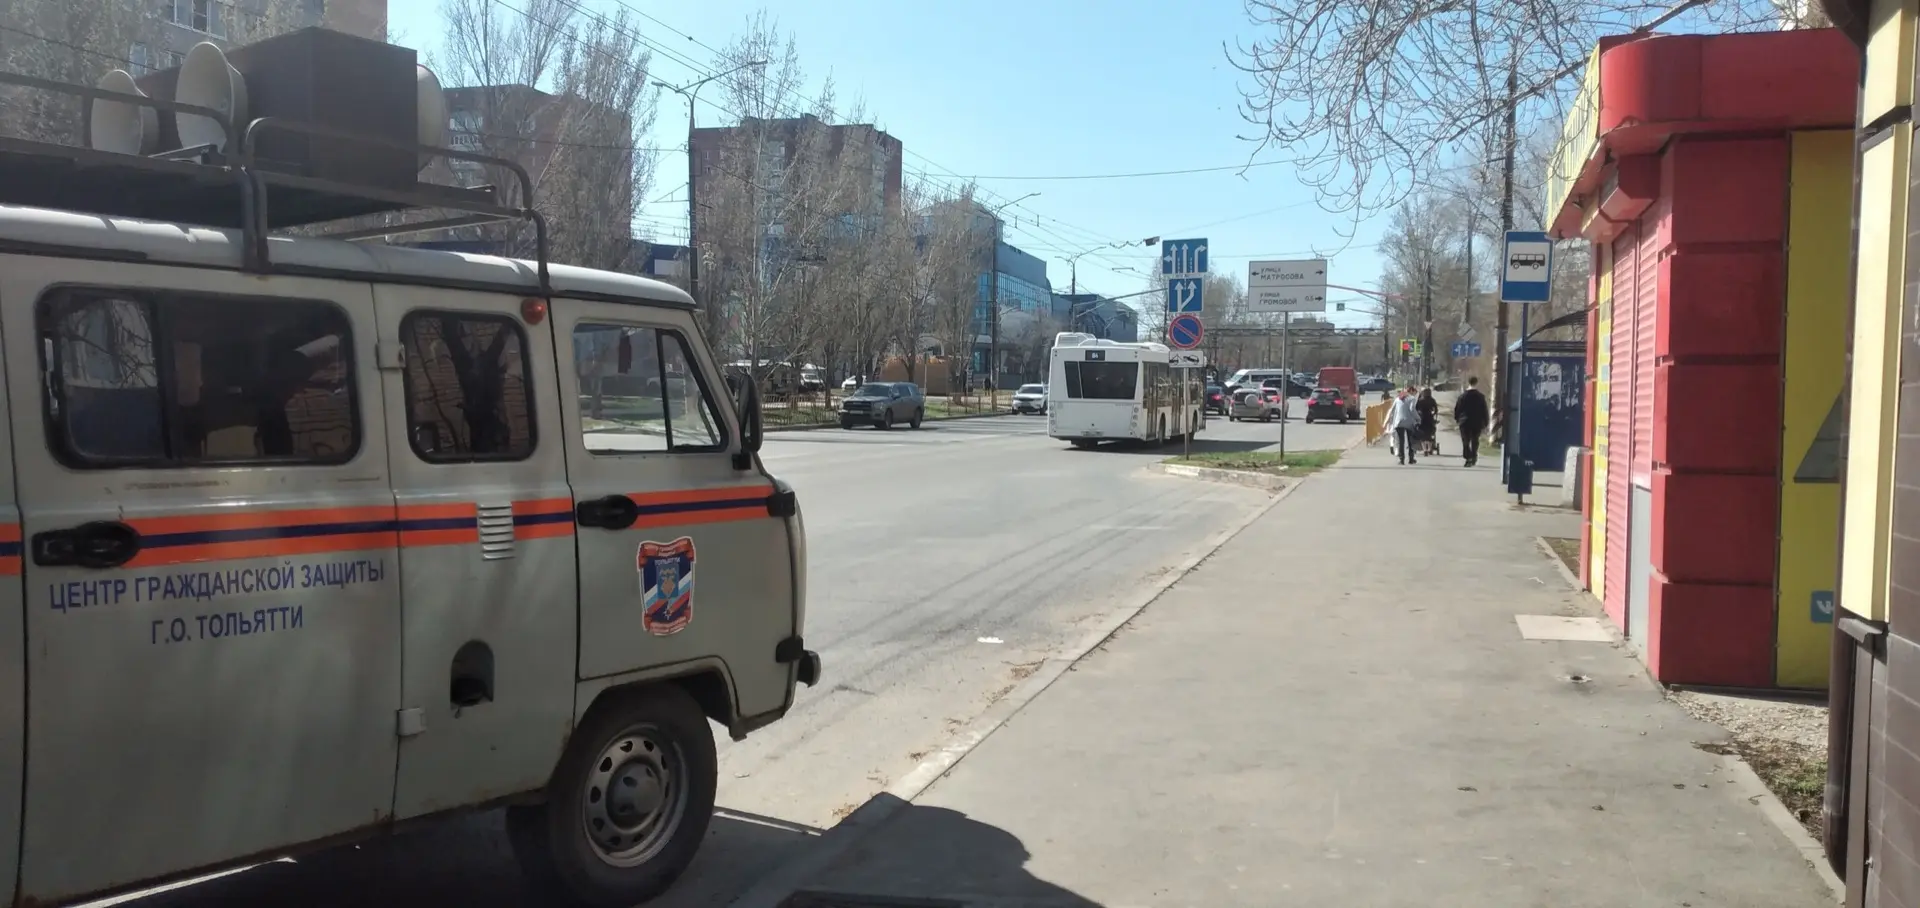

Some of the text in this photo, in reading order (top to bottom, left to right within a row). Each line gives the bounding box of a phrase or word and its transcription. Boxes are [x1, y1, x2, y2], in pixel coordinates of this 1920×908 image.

[48, 559, 385, 614] ЦЕНТР ГРАЖДАНСКОЙ ЗАЩИТЫ
[151, 605, 304, 645] Г.О. ТОЛЬЯТТИ
